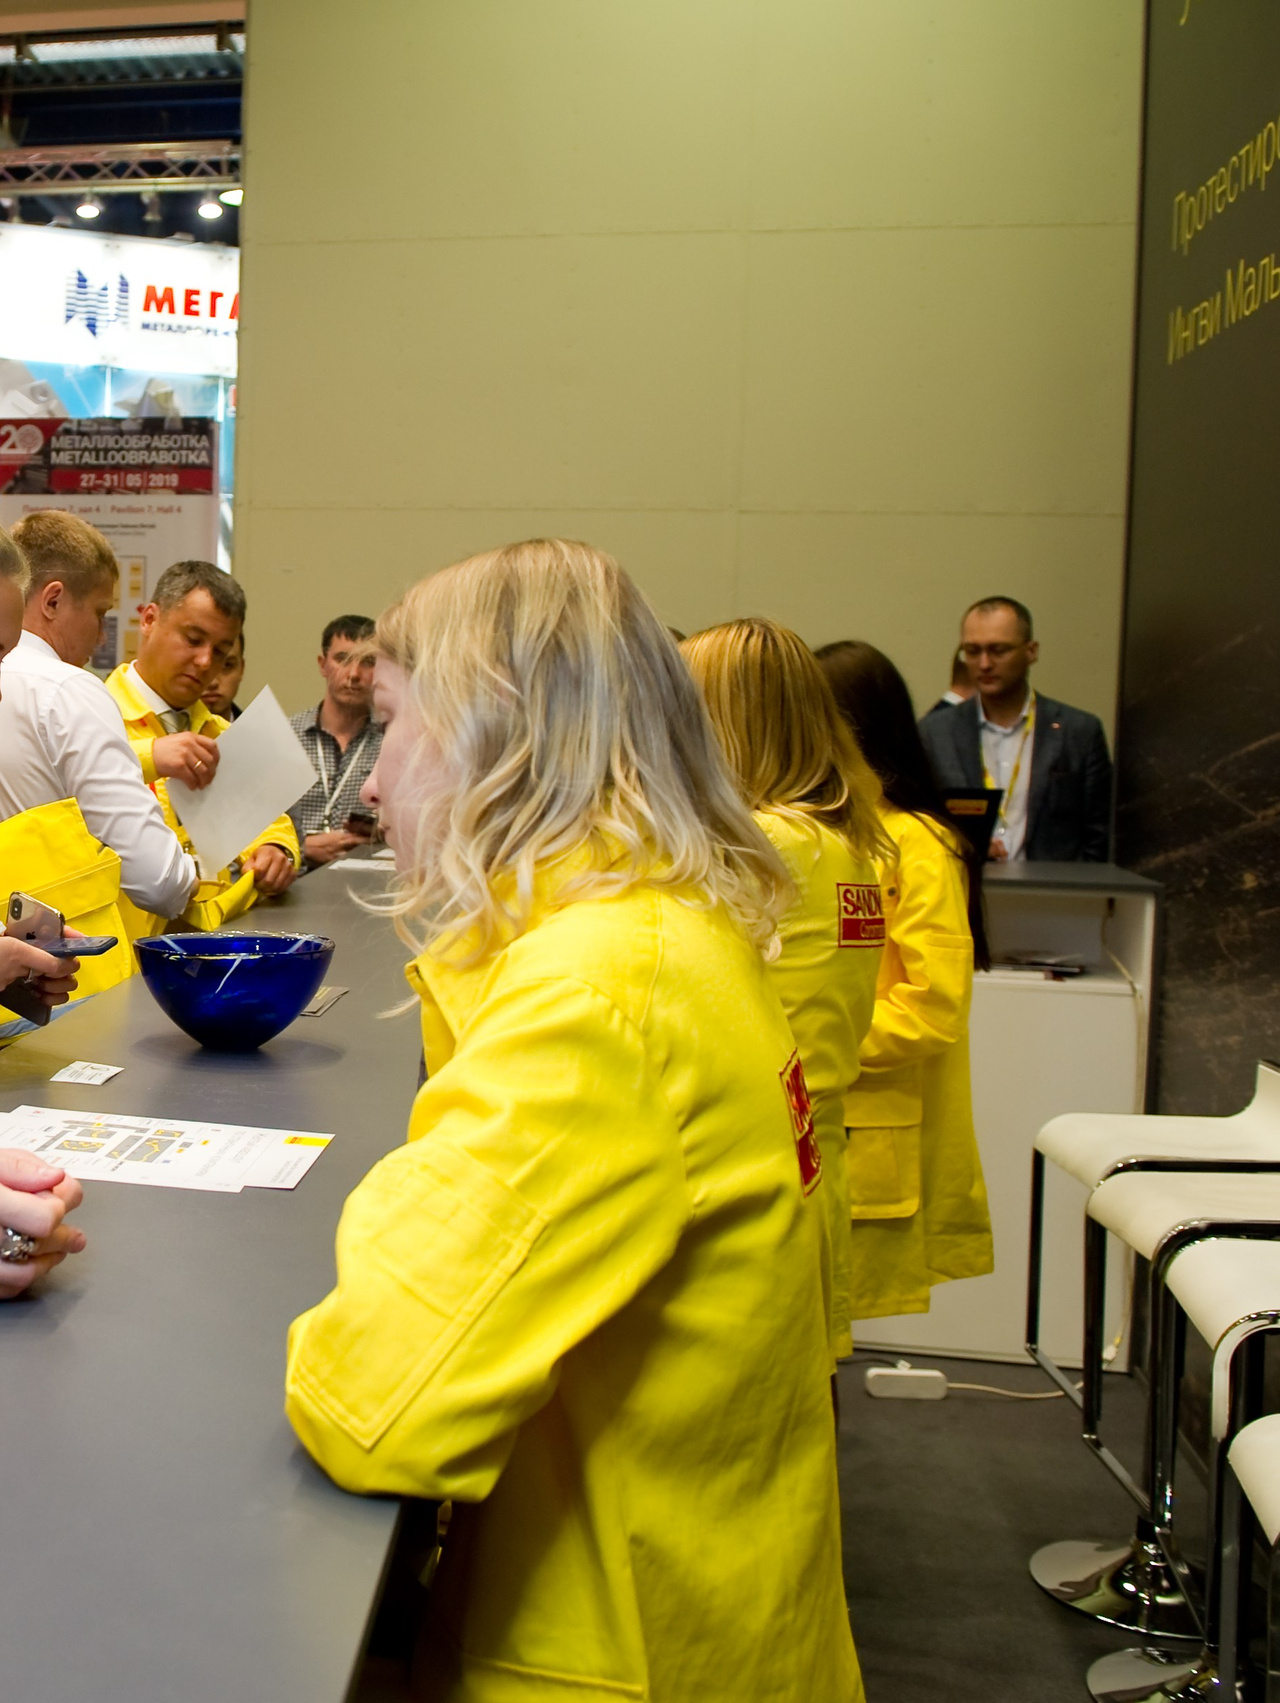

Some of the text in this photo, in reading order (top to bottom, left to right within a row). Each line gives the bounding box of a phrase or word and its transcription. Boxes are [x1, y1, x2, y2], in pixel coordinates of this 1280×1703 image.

[1167, 291, 1221, 365] Ингви
[50, 434, 210, 449] МЕТАЛЛООБРАБОТКА
[50, 450, 210, 465] METALLOOBRABOTKA
